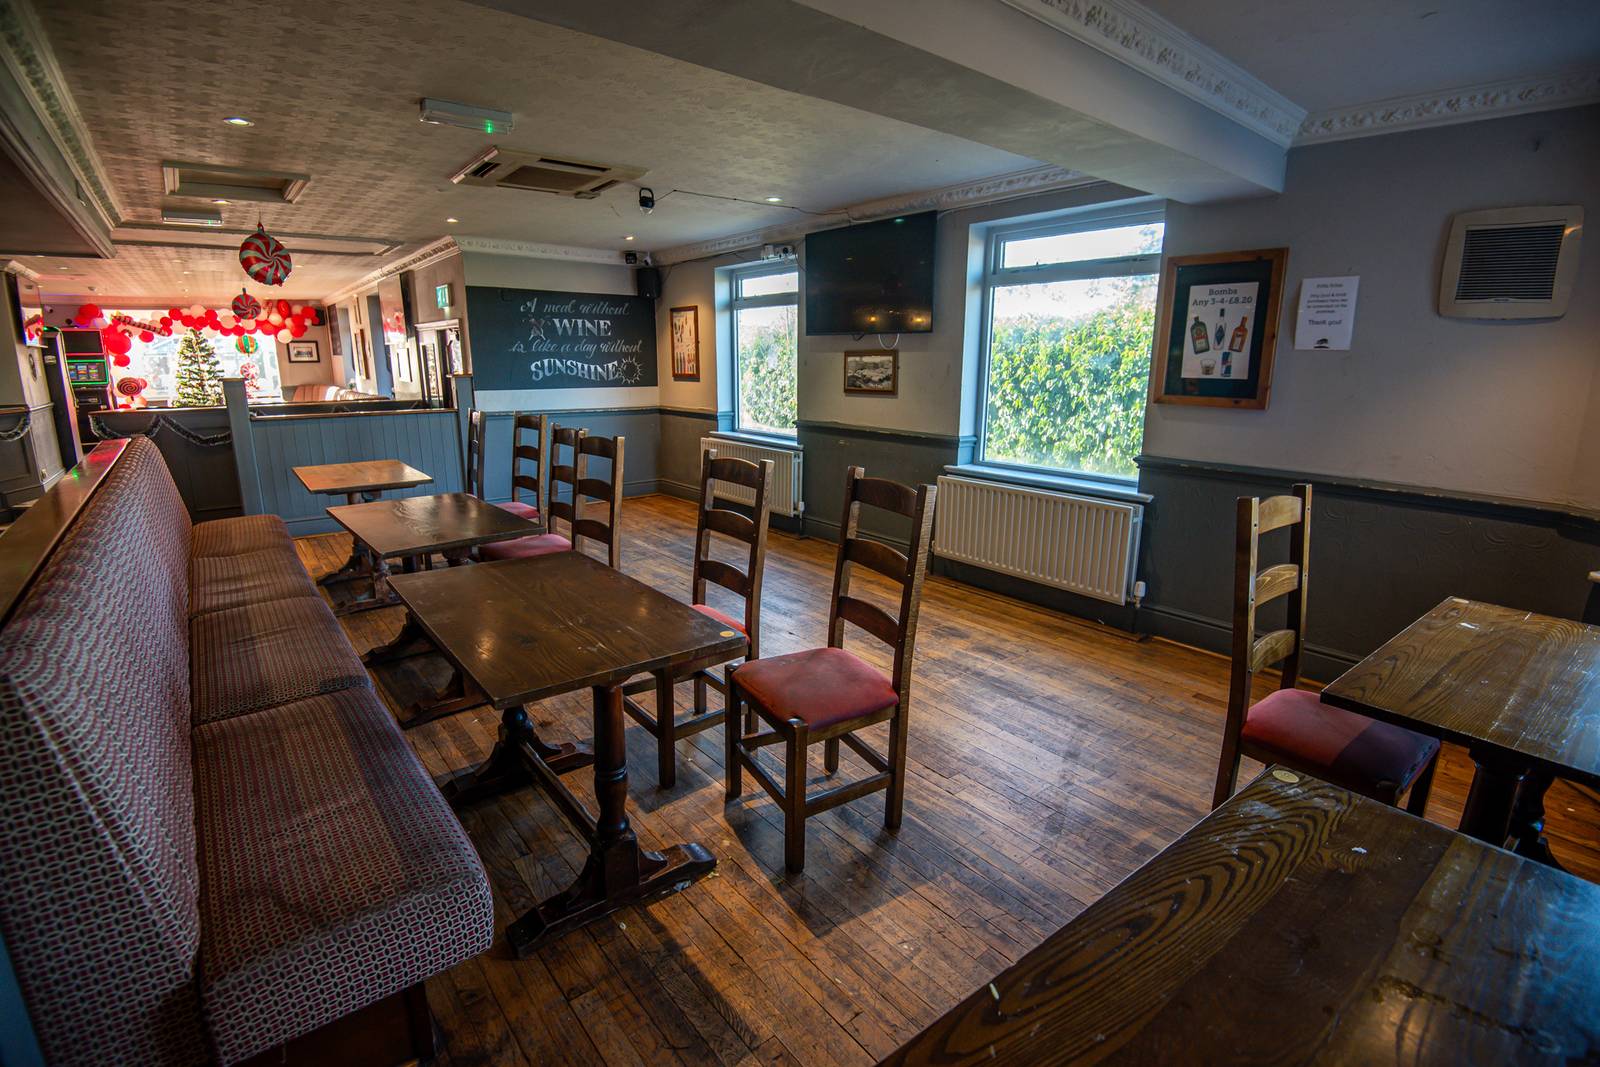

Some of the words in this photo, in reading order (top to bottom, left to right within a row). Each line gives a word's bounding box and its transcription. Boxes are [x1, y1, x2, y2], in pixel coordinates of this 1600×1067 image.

[1208, 287, 1238, 296] Bombs
[520, 297, 537, 312] A
[544, 299, 575, 313] meal
[580, 301, 630, 315] without
[1192, 298, 1209, 307] Any
[552, 318, 612, 337] WINE
[508, 340, 527, 353] is
[532, 338, 557, 353] like
[560, 343, 572, 353] a
[575, 338, 598, 358] day
[600, 340, 643, 353] without
[530, 358, 620, 382] SUNSHINE
